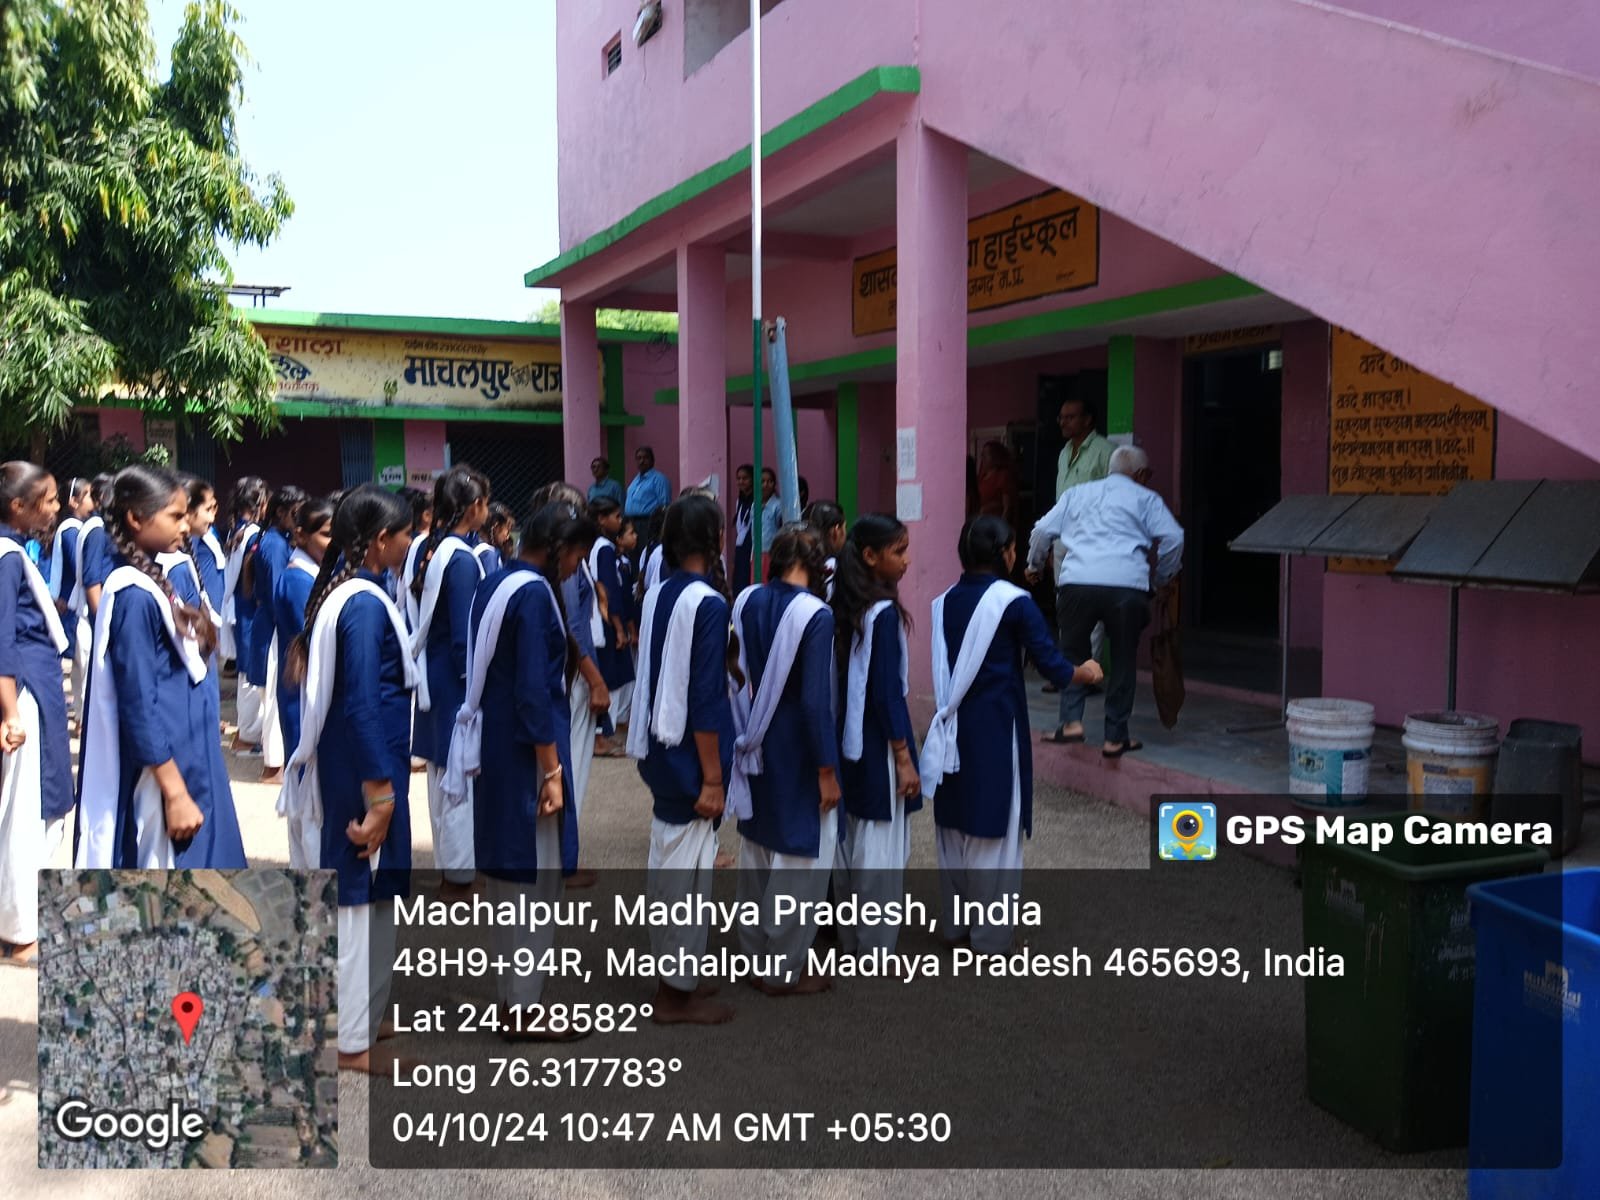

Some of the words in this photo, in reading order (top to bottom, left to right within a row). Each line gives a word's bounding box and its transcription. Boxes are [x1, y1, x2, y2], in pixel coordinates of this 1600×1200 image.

[983, 206, 1080, 271] हाईस्कूल
[403, 354, 513, 400] माचलपुर
[531, 361, 562, 393] राज
